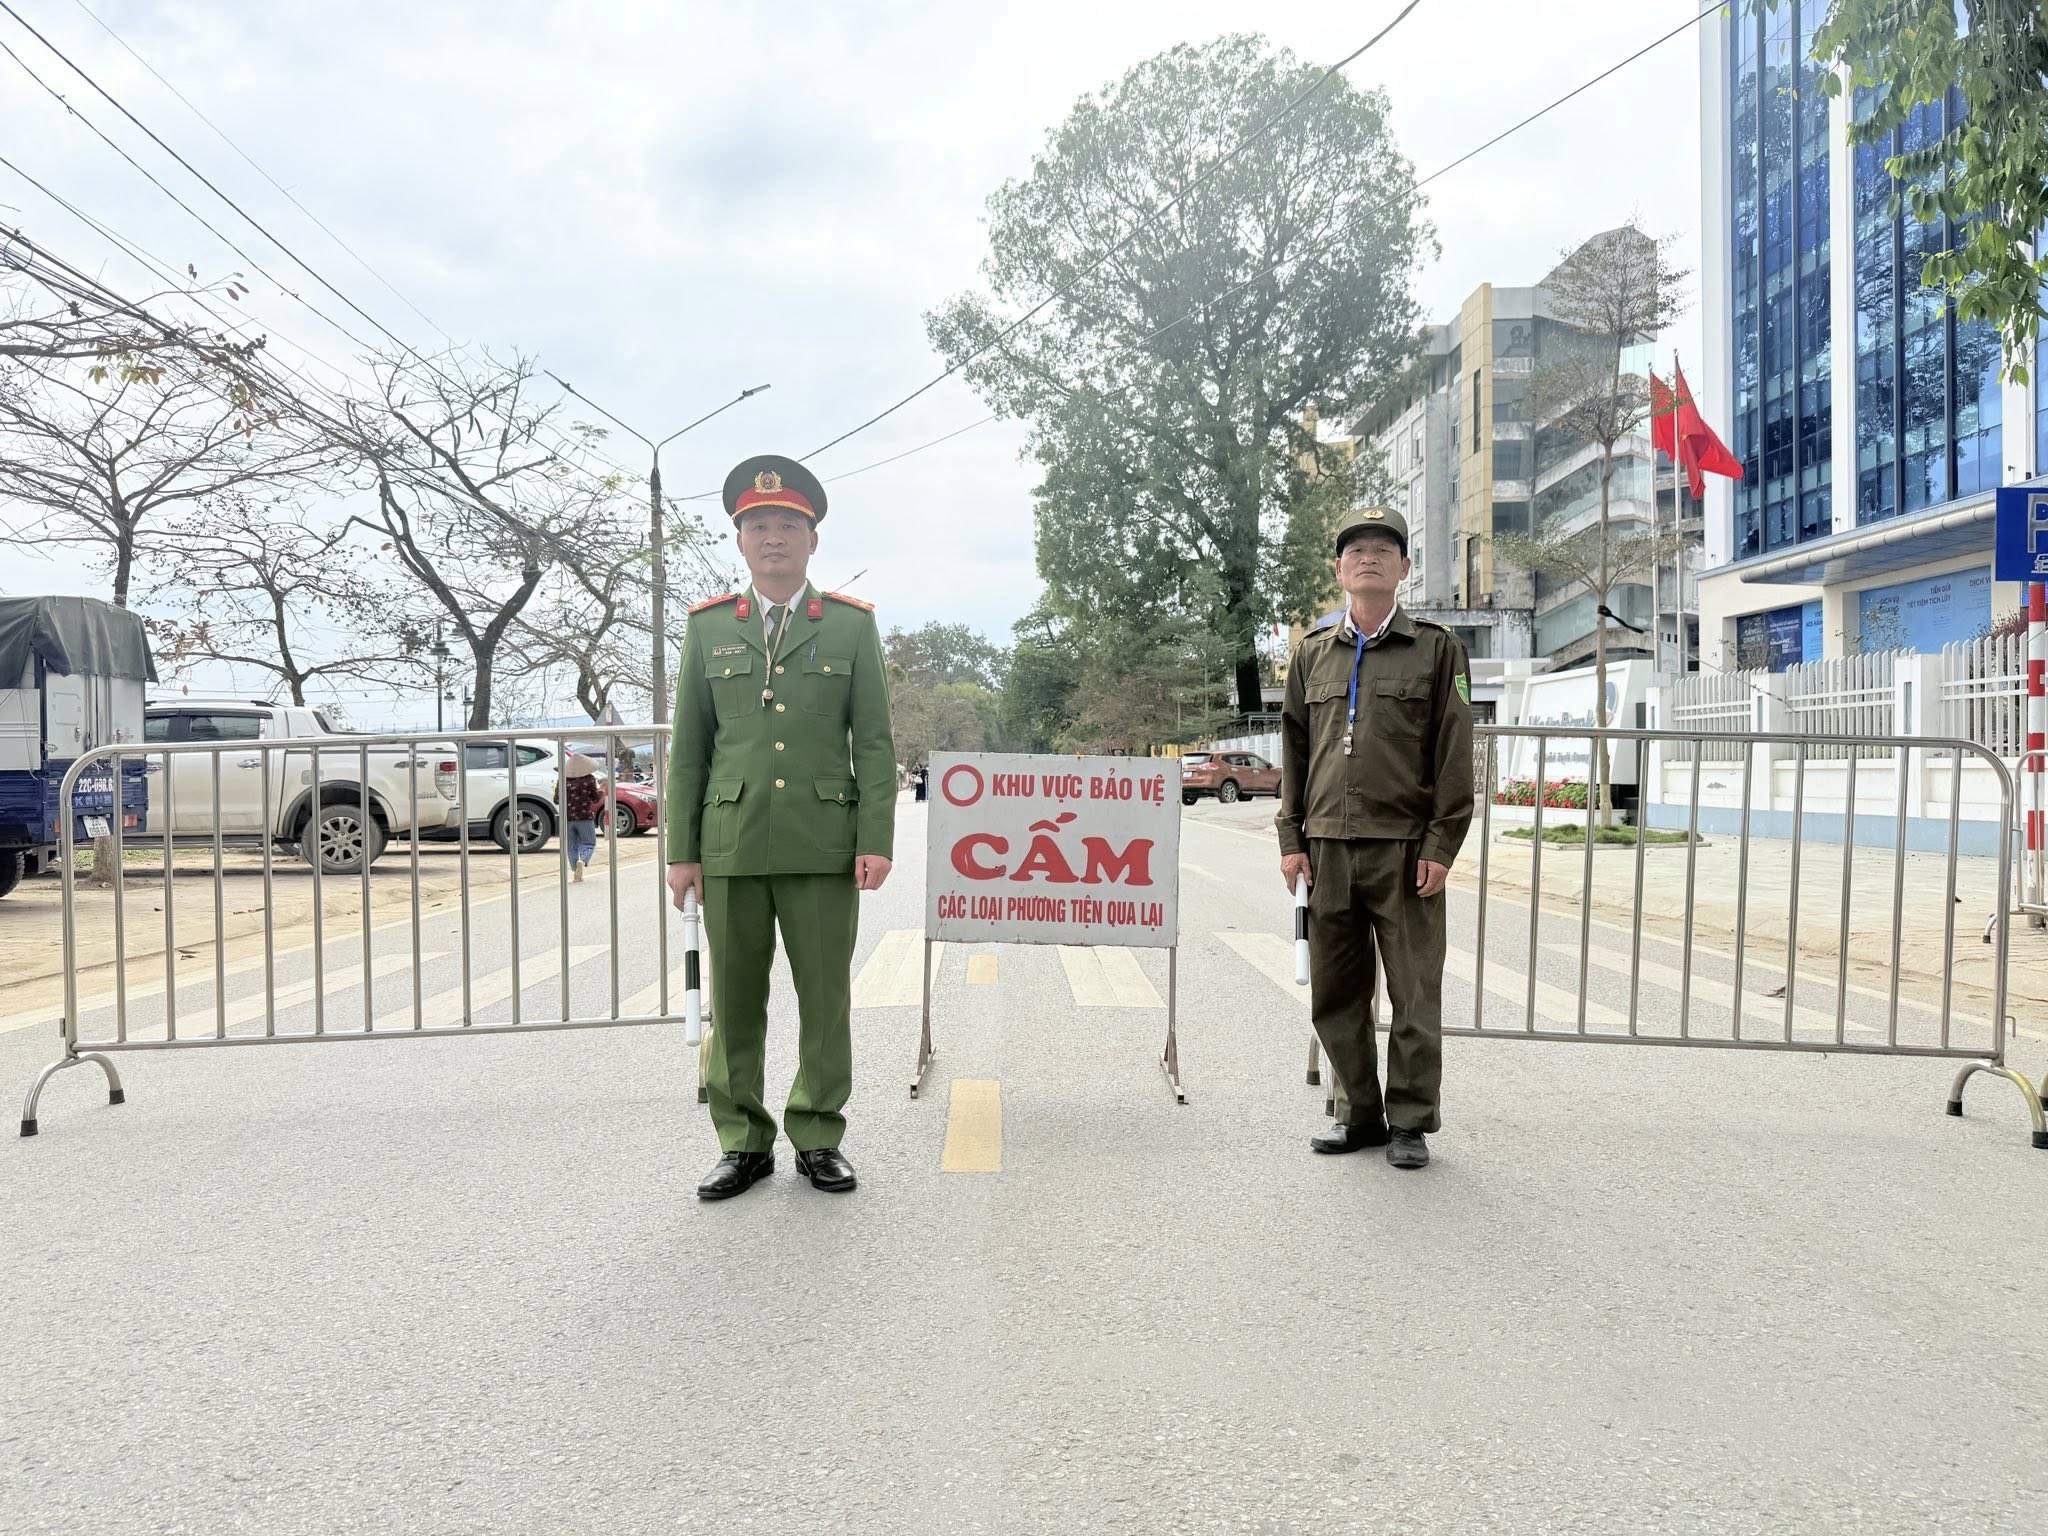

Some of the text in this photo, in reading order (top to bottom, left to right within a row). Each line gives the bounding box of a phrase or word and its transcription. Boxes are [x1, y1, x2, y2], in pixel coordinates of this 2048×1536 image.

[992, 767, 1165, 806] KHU VỰC BẢO VỆ
[950, 811, 1155, 886] CẤM
[937, 890, 1164, 931] CÁC LOẠI PHƯƠNG TIỆN QUA LẠI
